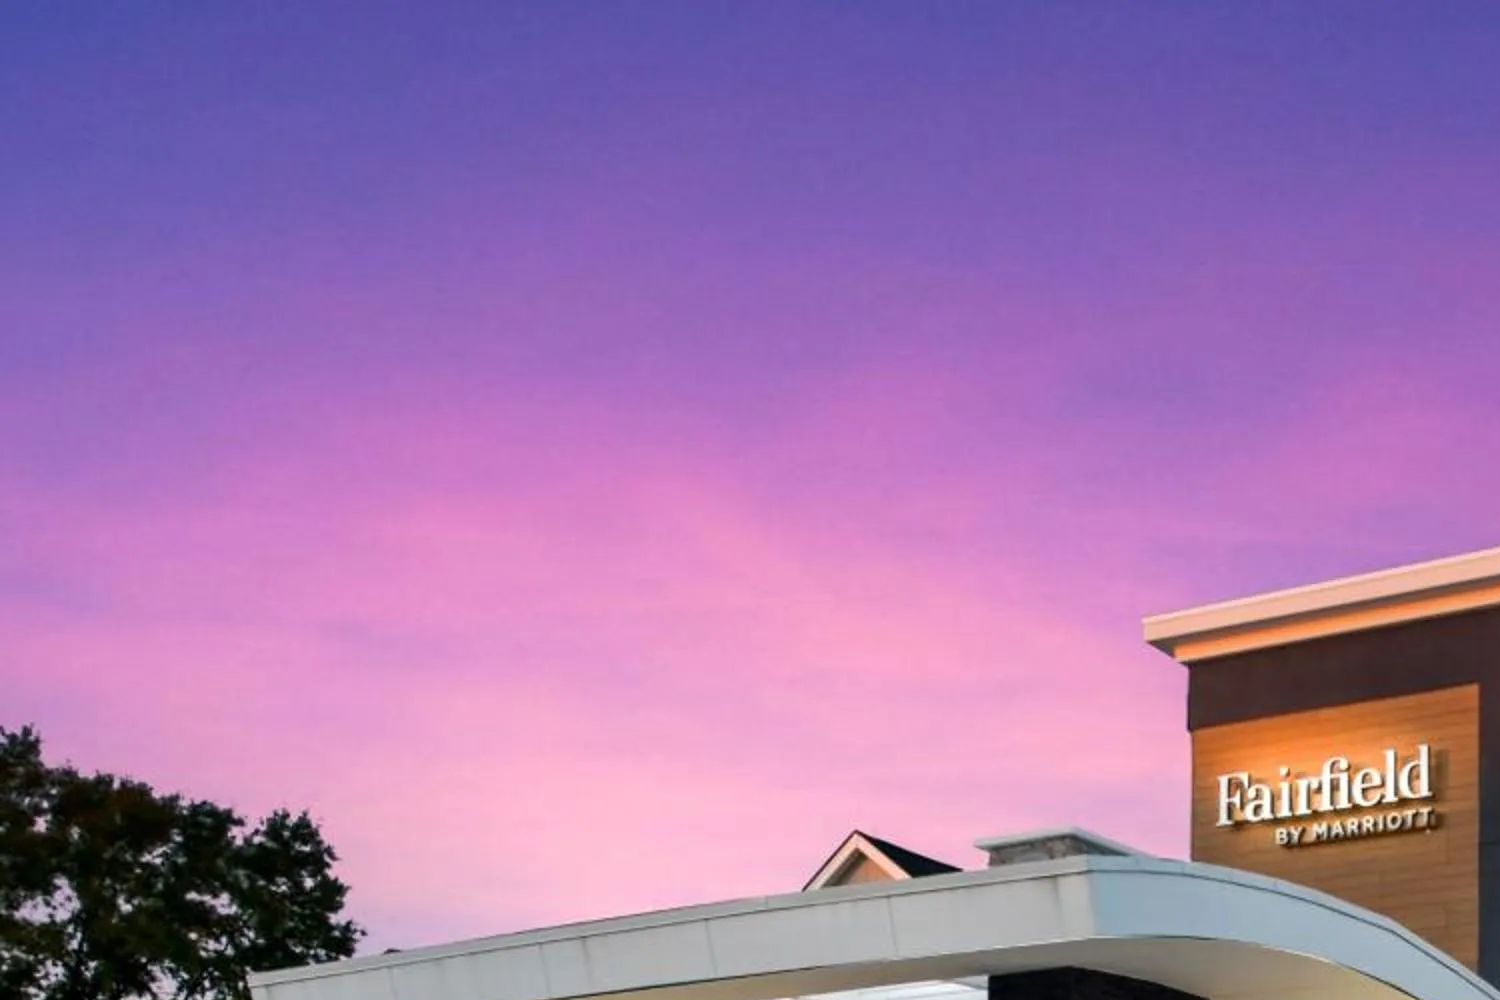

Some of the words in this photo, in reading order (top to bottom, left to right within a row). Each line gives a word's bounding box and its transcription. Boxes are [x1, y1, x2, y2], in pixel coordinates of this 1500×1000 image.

[1216, 744, 1432, 827] Fairfield
[1275, 826, 1303, 845] BY
[1312, 807, 1434, 841] MARRIOTT
